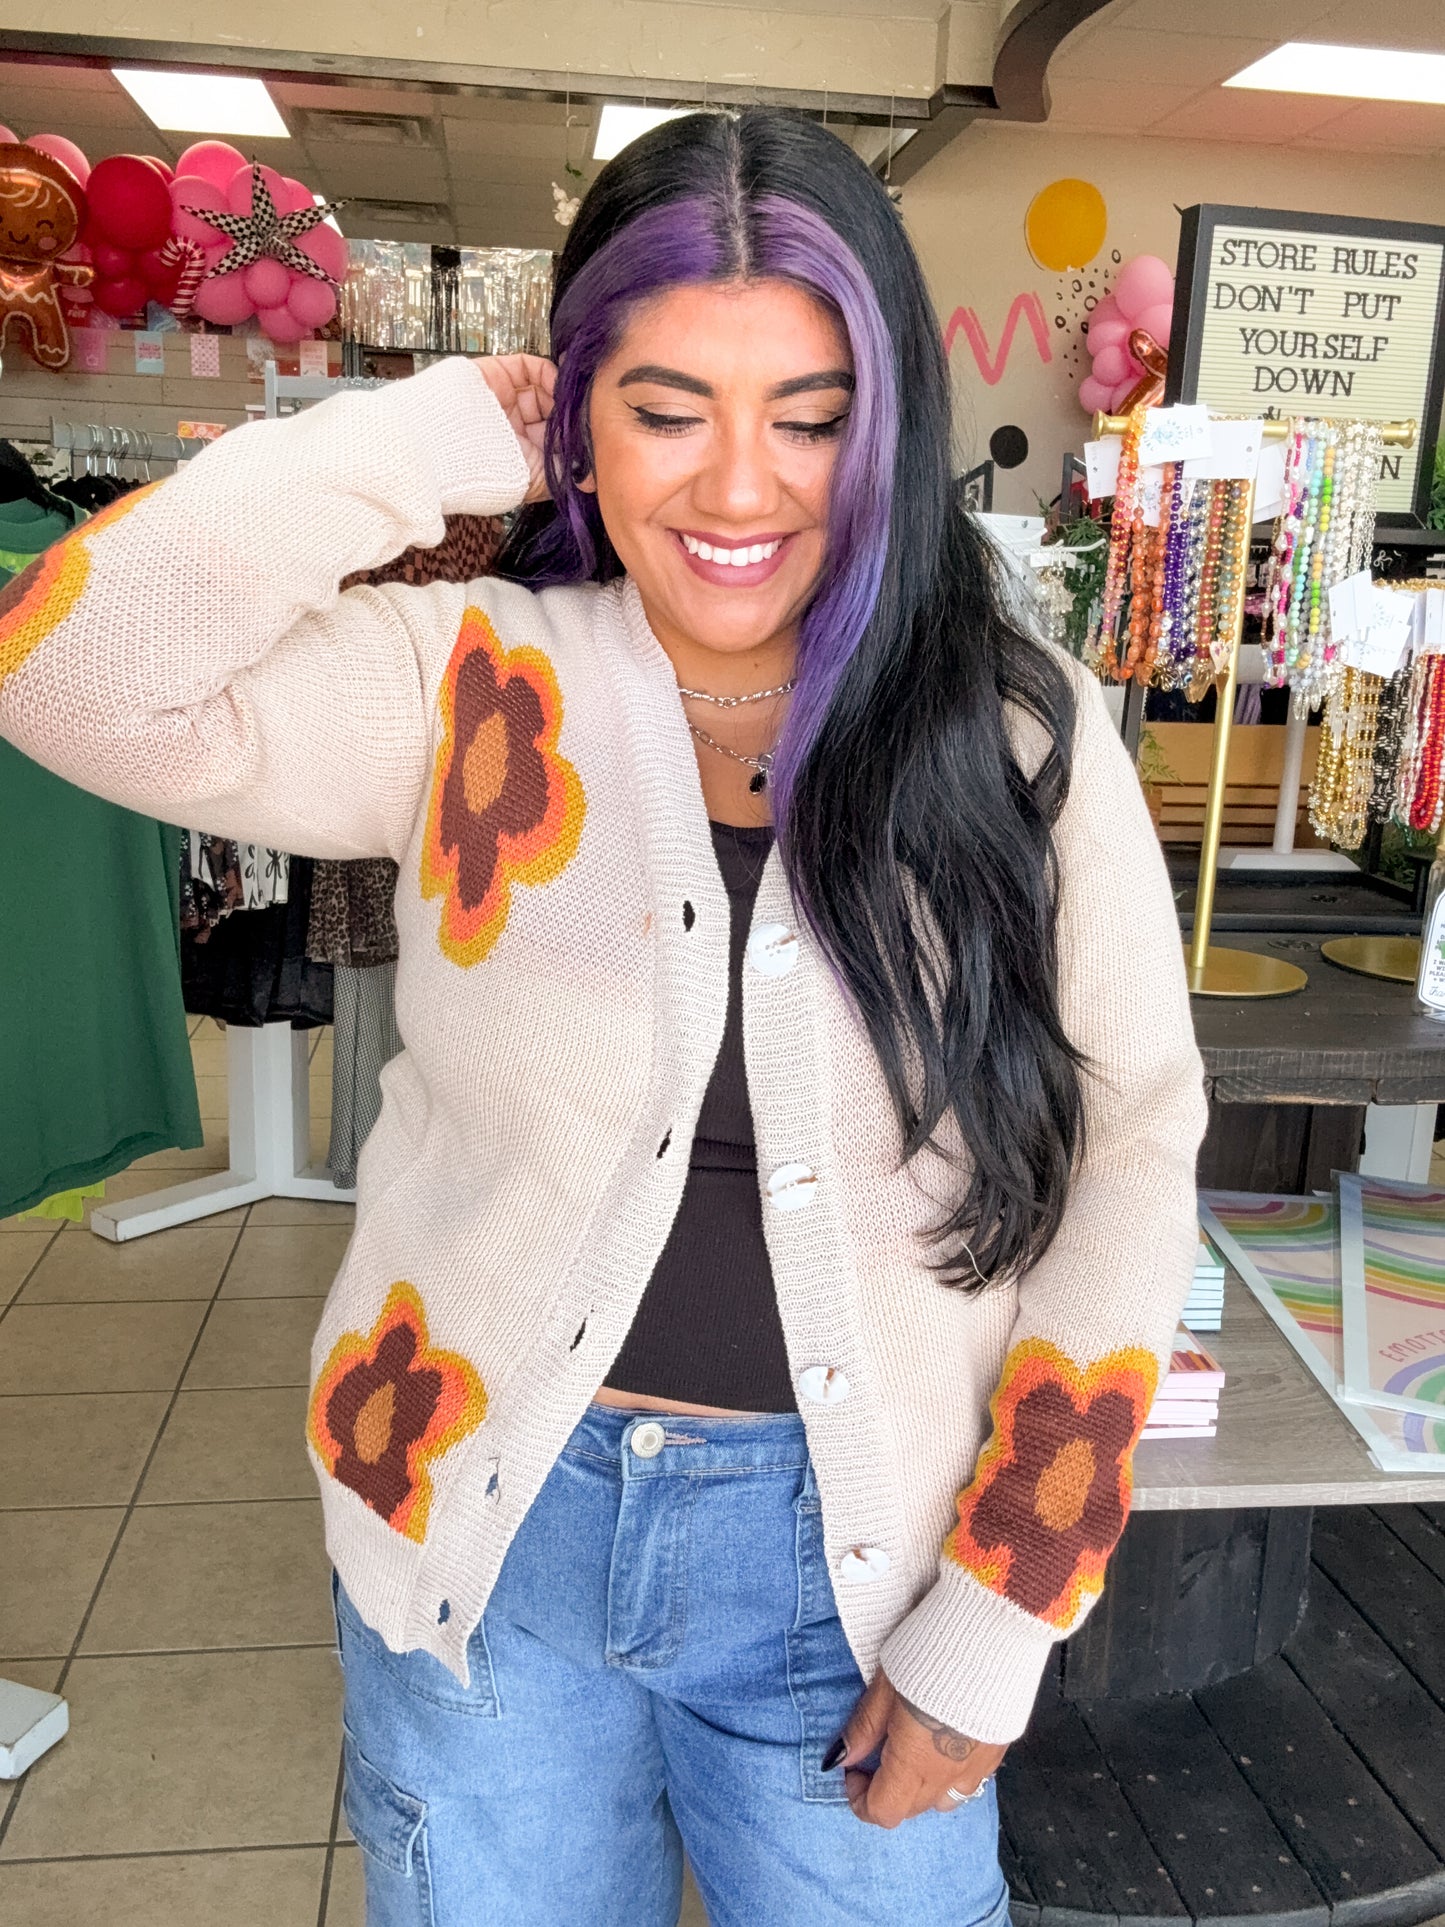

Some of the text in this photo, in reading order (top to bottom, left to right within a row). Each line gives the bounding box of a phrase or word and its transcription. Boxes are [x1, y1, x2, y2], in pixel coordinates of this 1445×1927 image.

[1220, 238, 1419, 280] STORE RULES
[1213, 282, 1402, 321] DON'T PUT
[1239, 327, 1389, 362] YOURSELF
[1252, 366, 1355, 397] DOWN
[1378, 1329, 1445, 1363] EMOTI
